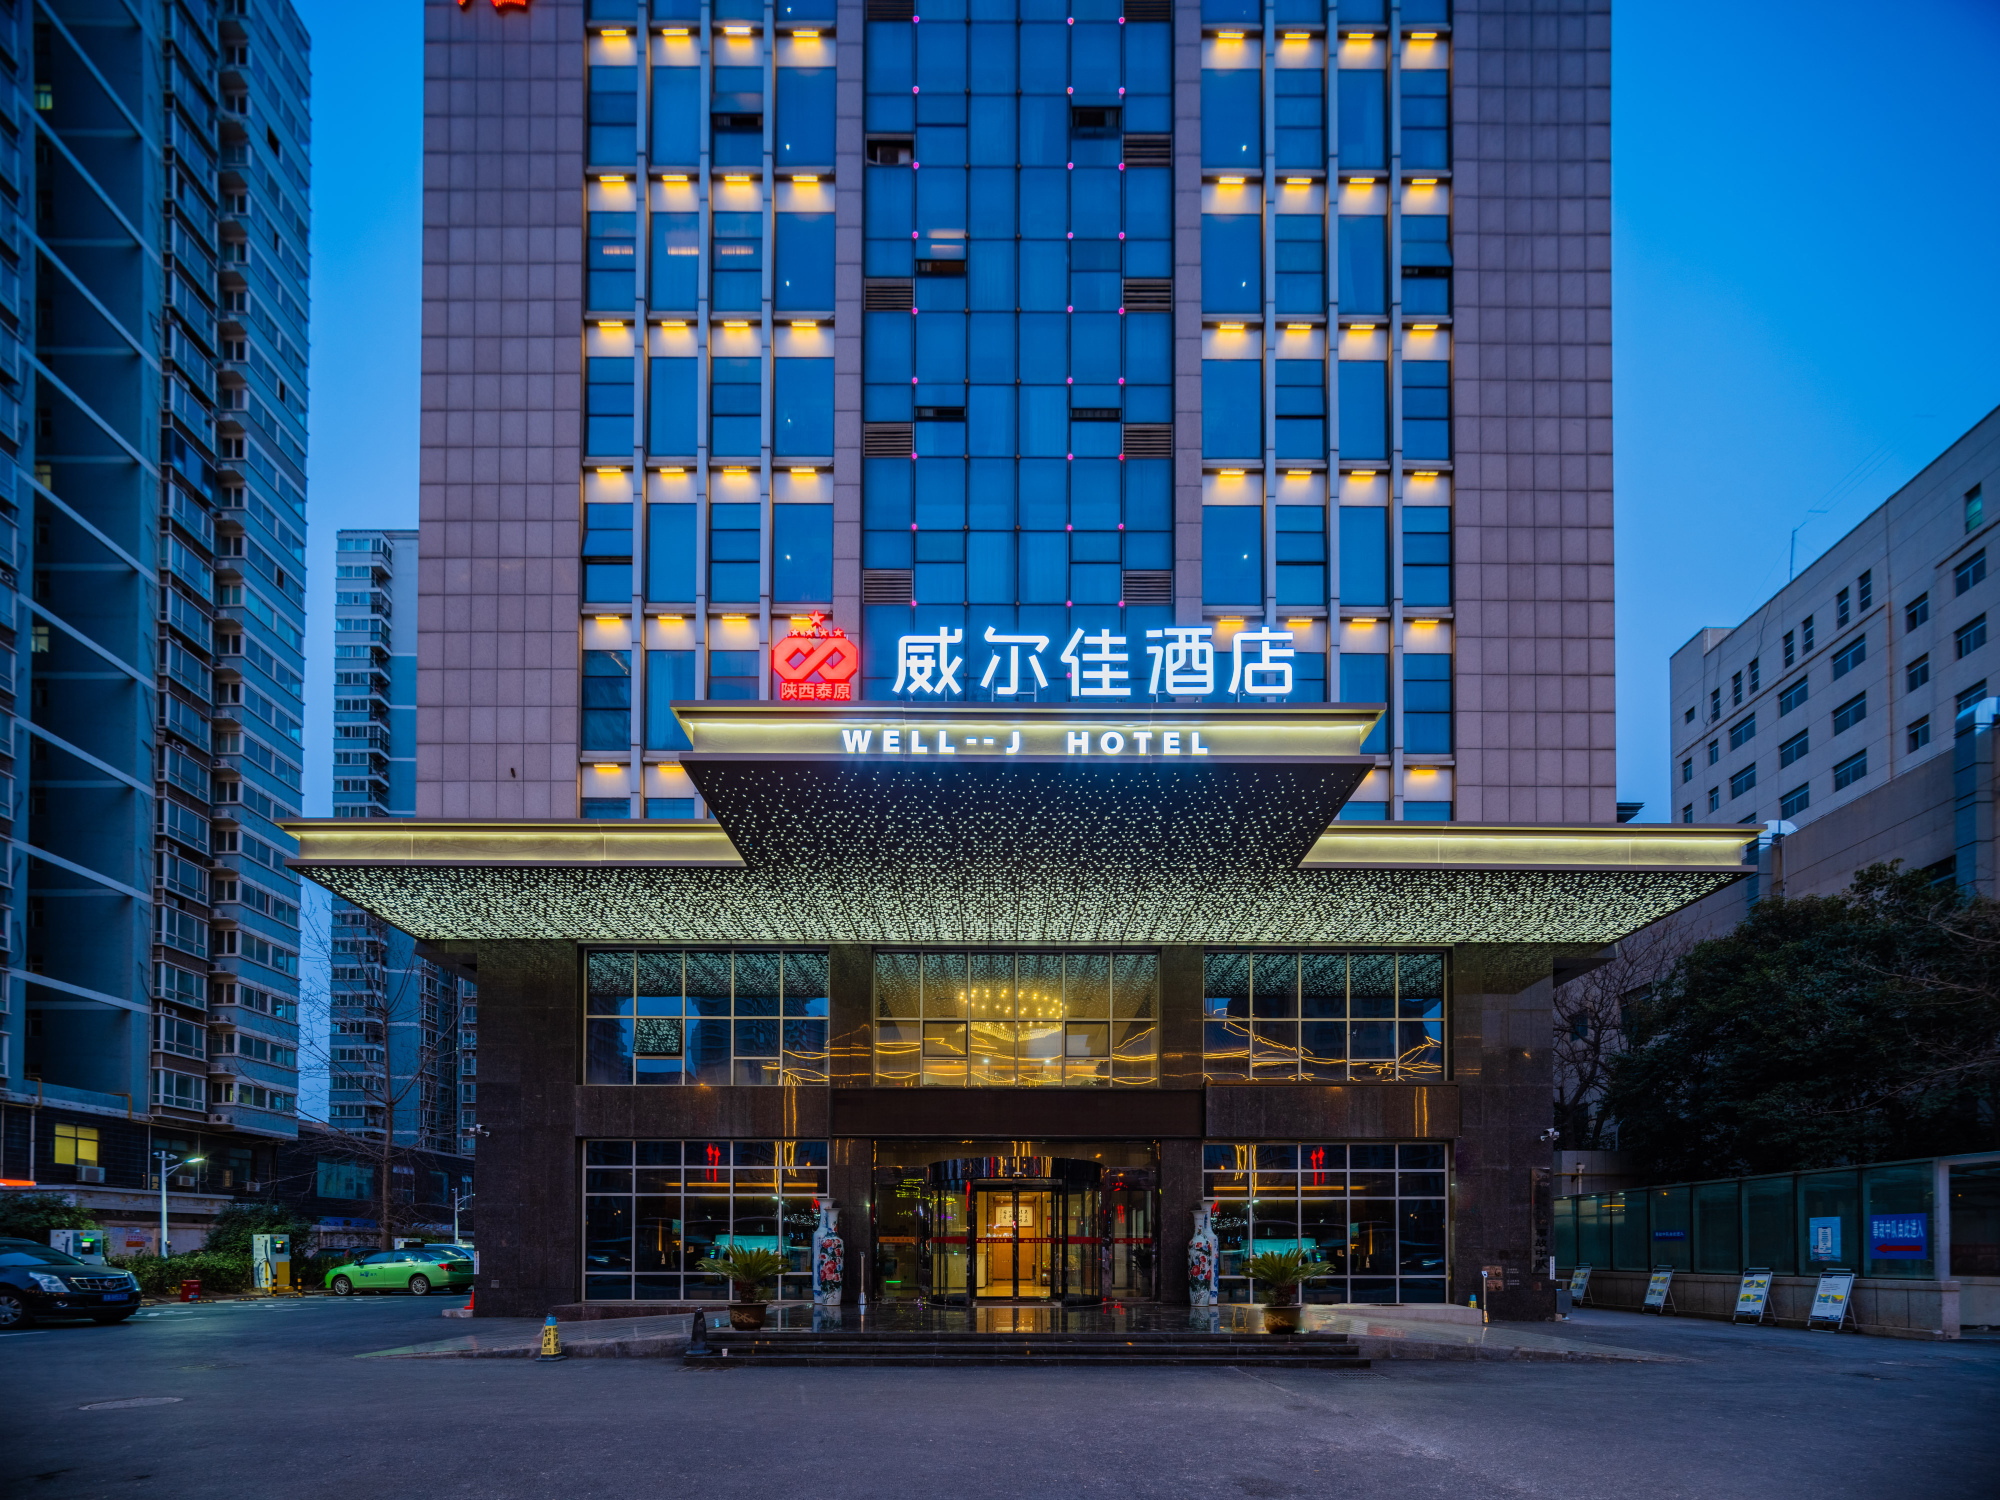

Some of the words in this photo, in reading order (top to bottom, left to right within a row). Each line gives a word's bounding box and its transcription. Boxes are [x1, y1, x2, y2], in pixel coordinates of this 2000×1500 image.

[892, 626, 1295, 697] 威尔佳酒店
[780, 682, 851, 700] 陕西泰原
[1067, 731, 1209, 755] HOTEL
[1872, 1219, 1924, 1239] 事故中队由此进入
